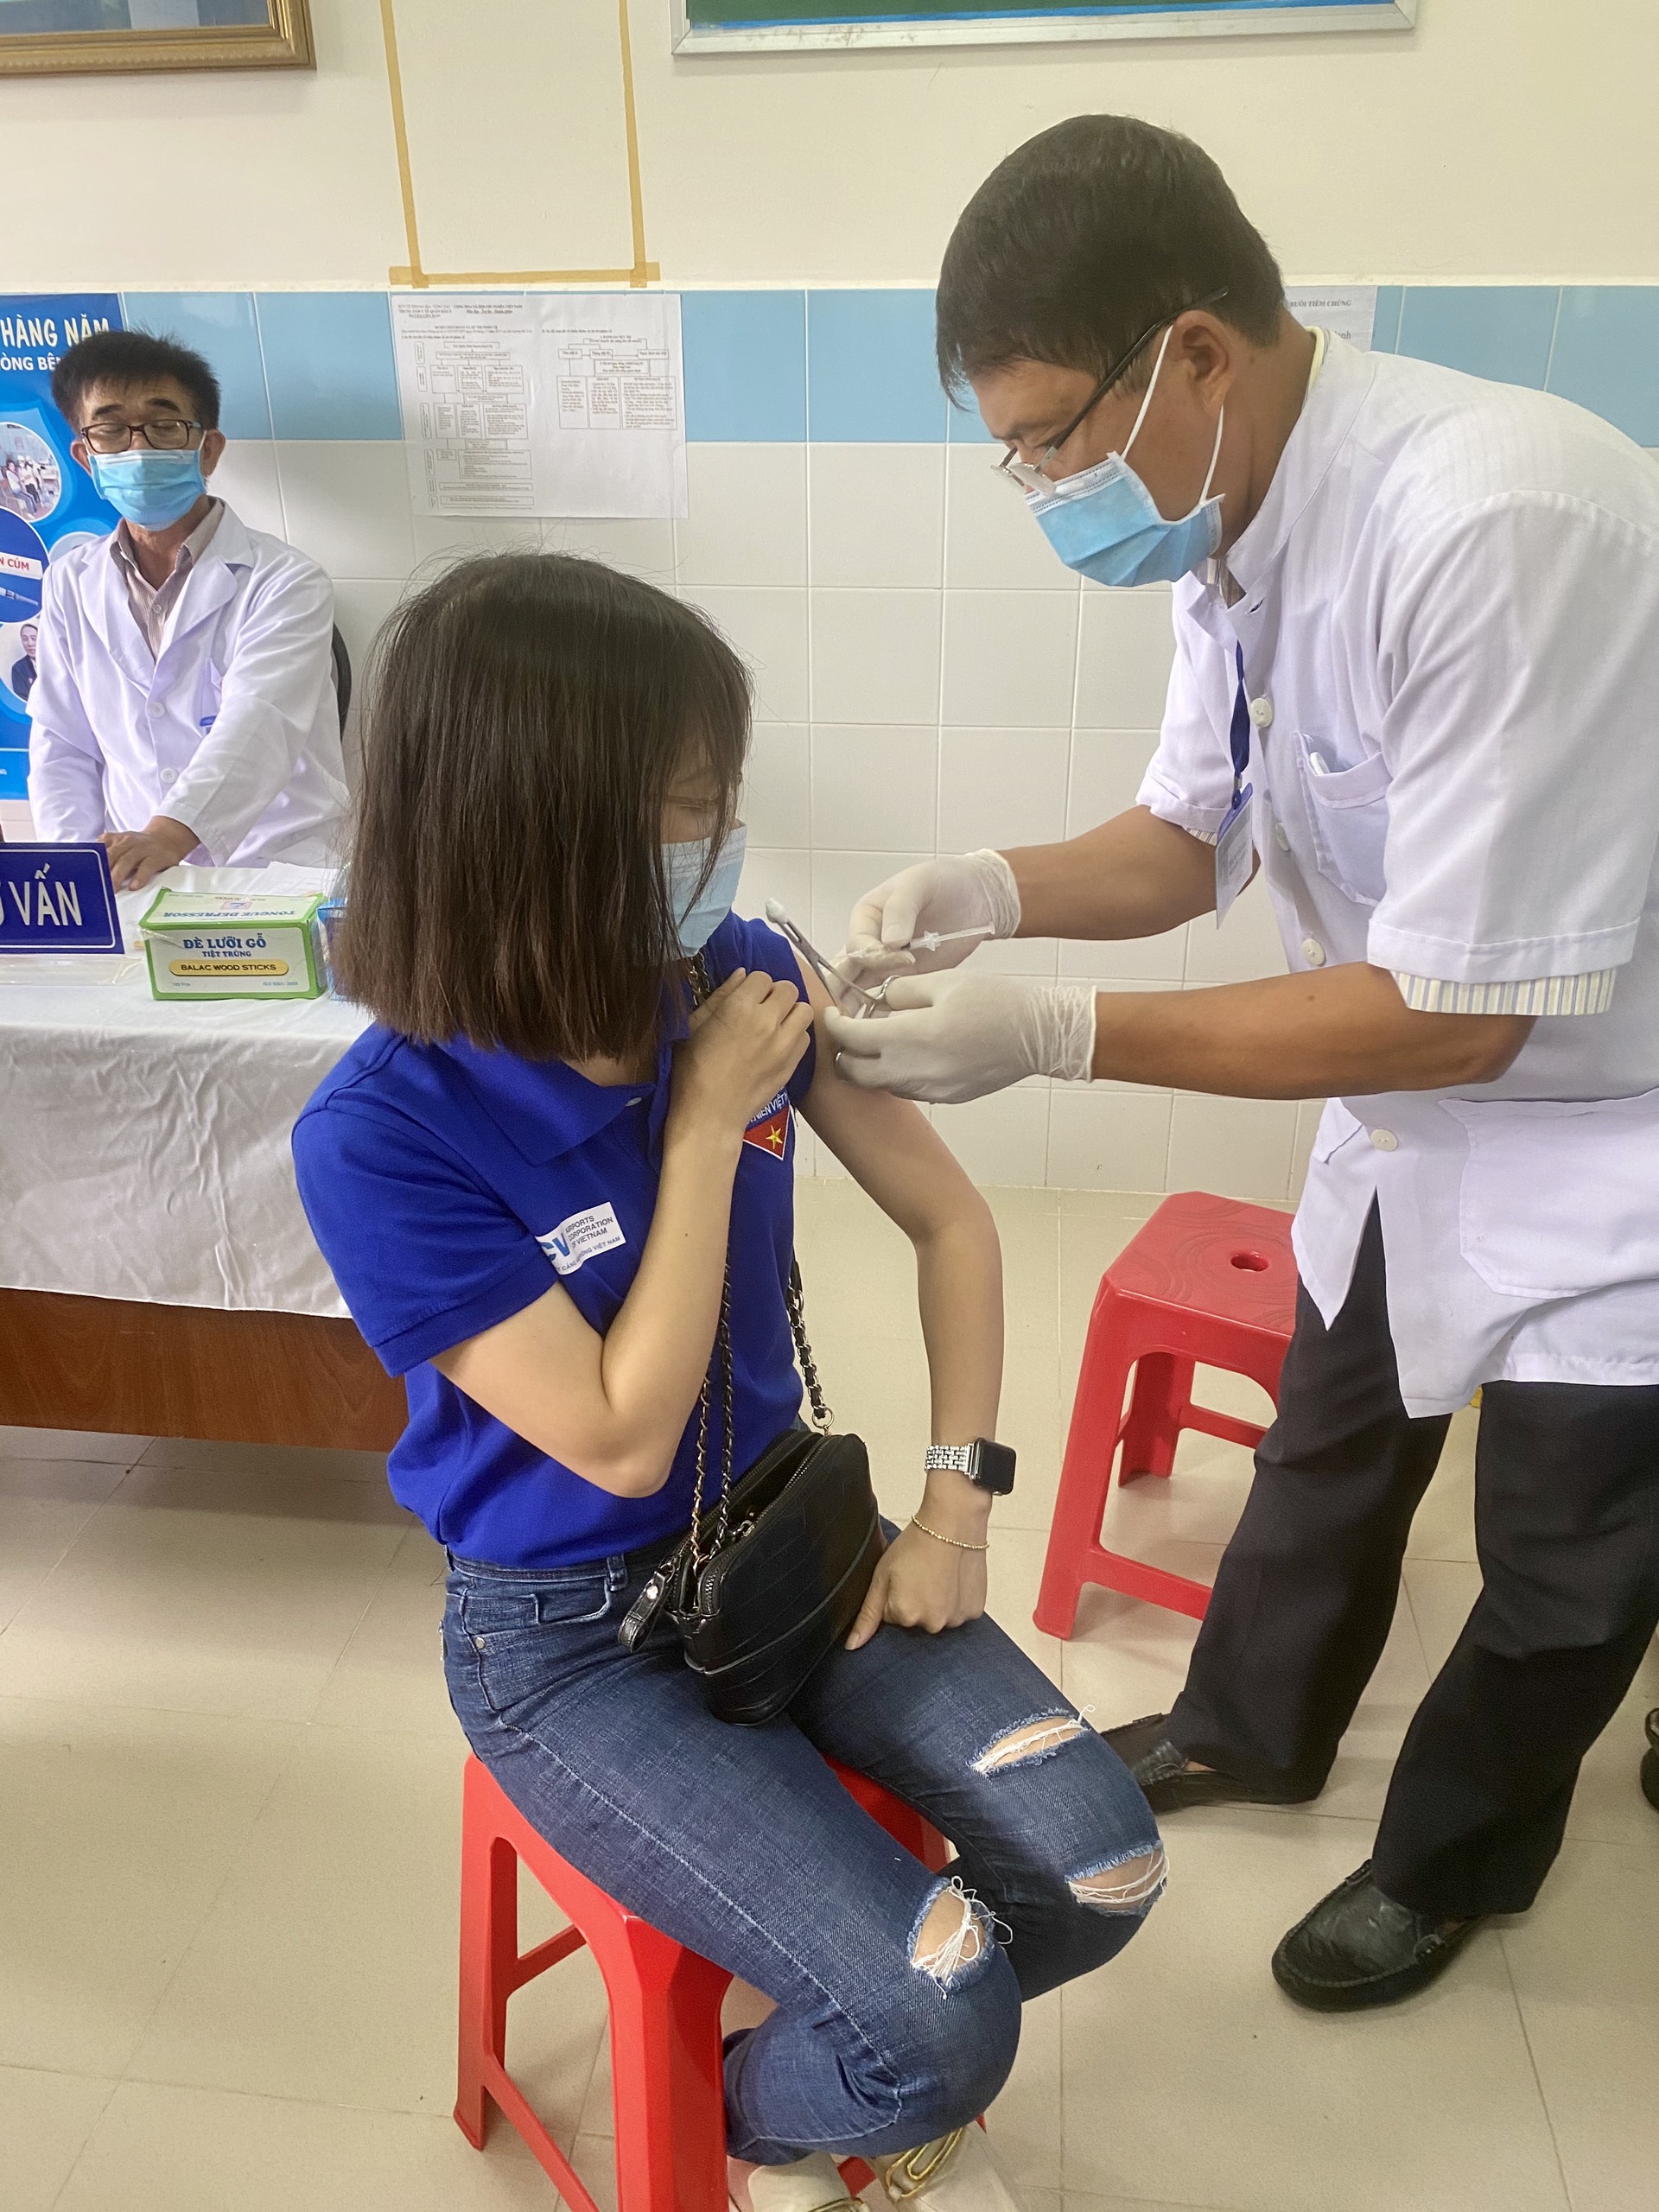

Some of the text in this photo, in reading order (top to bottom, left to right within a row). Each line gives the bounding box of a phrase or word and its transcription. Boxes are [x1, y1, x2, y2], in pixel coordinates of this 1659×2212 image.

[0, 313, 58, 349] HÀNG
[8, 862, 83, 926] VẤN
[183, 937, 204, 950] ĐÈ
[245, 932, 267, 949] GỖ
[221, 948, 252, 957] TRÙNG
[575, 1227, 608, 1245] VIETNAM
[607, 1236, 620, 1246] NAM
